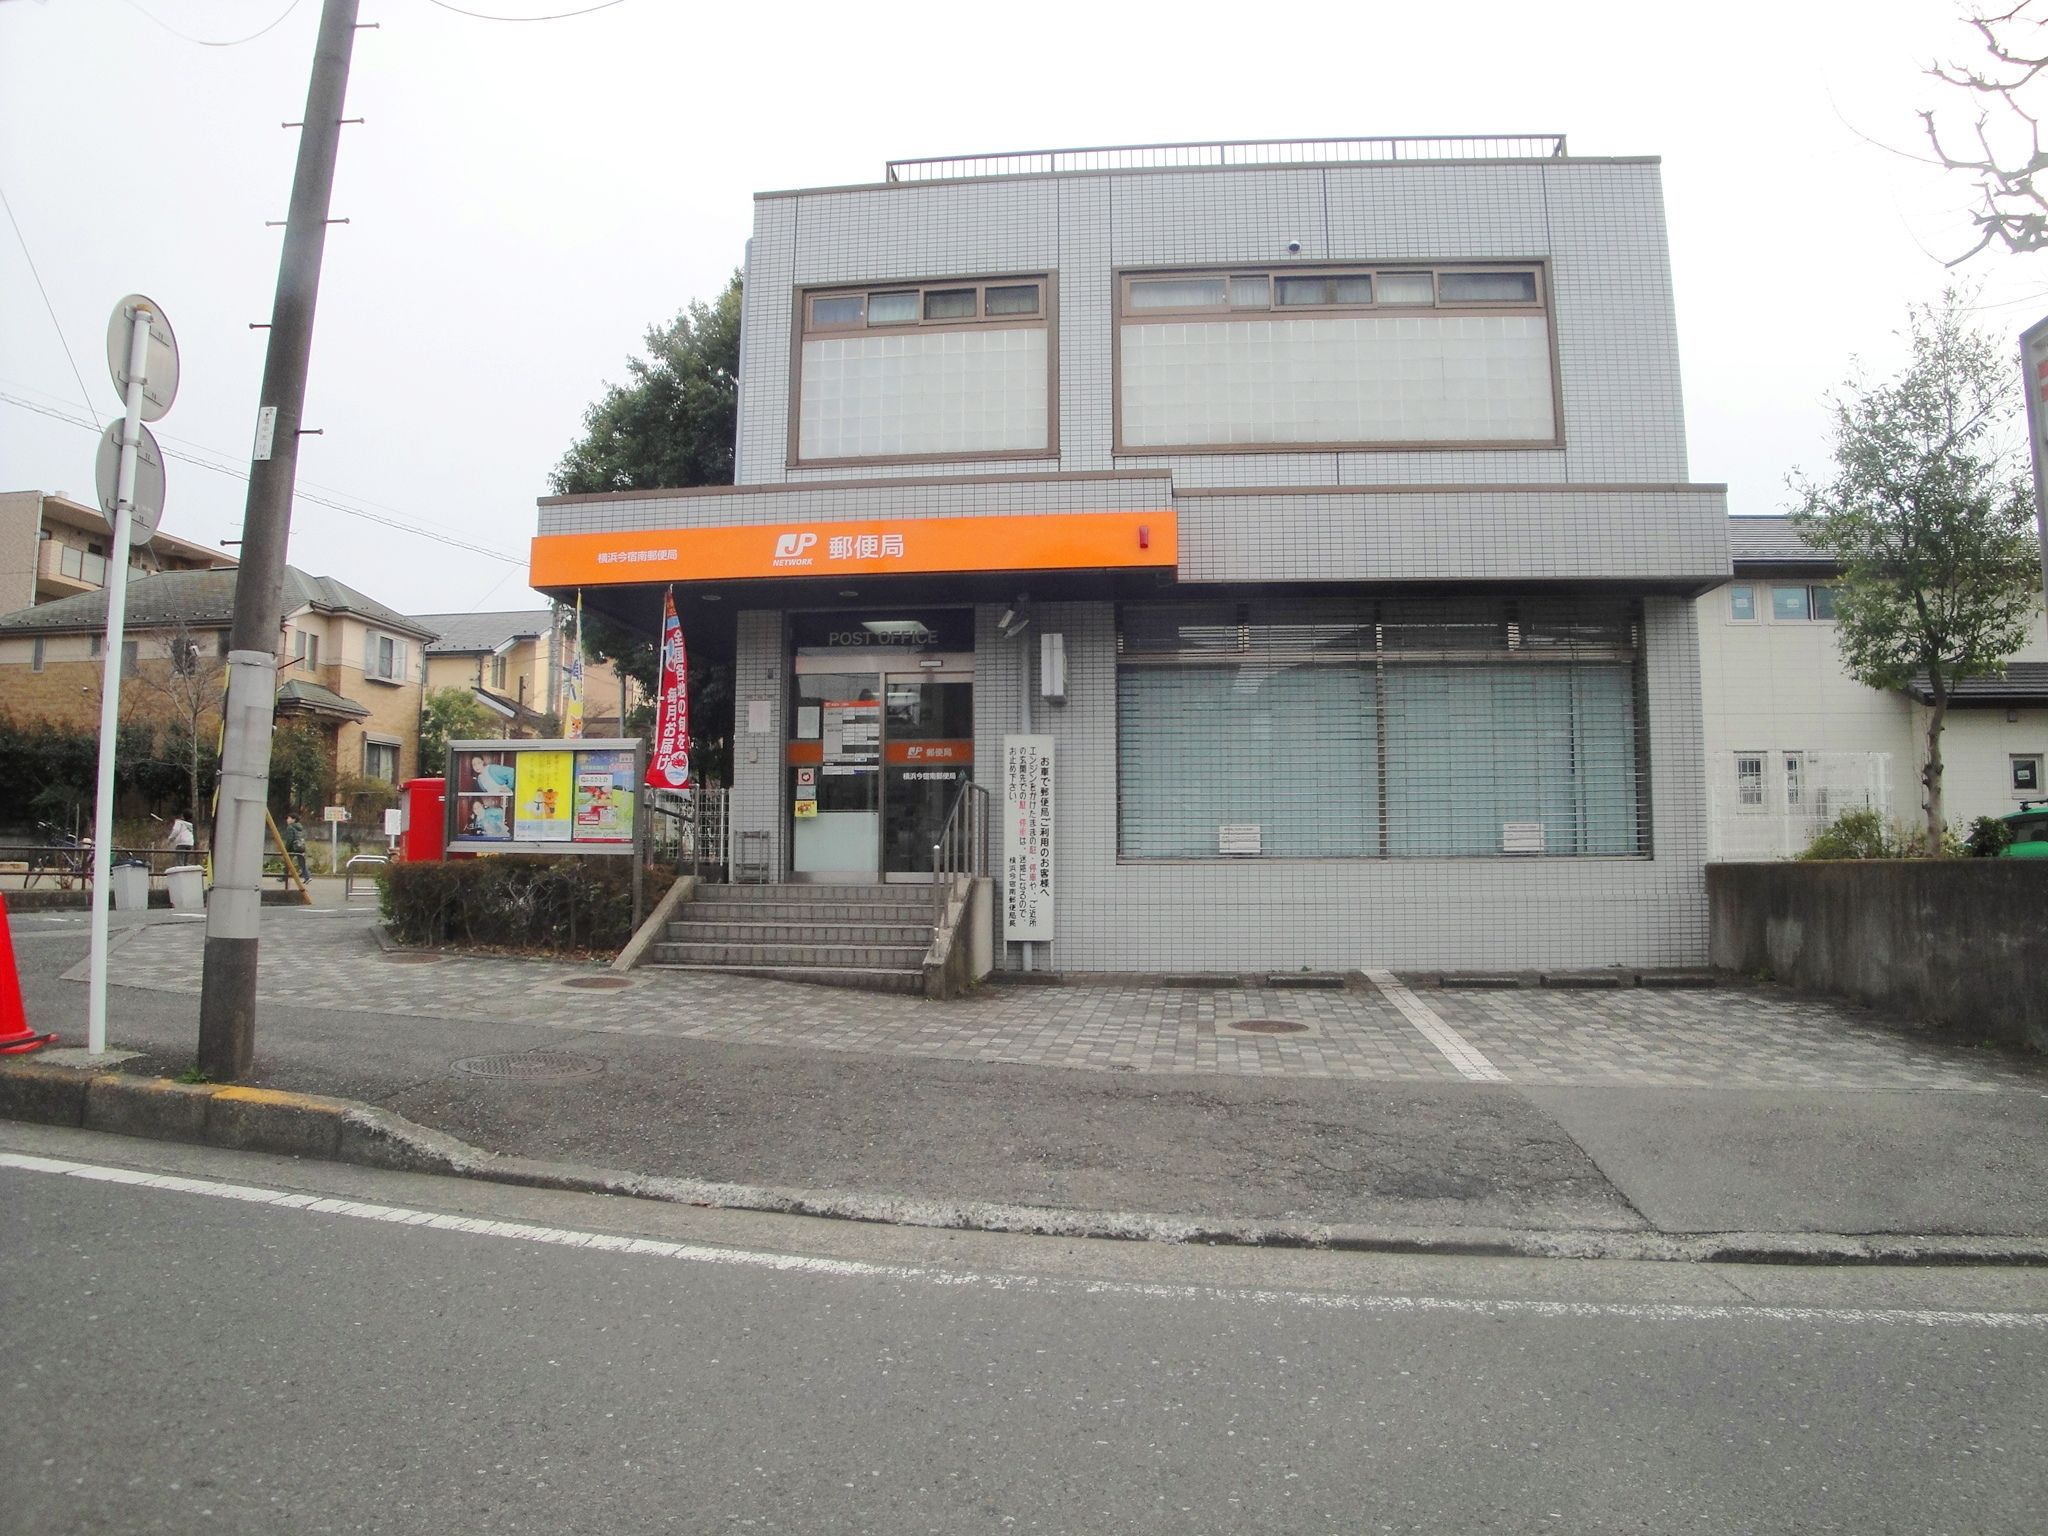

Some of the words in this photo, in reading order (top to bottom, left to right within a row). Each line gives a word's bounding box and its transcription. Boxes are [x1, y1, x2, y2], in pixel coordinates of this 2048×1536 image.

[597, 549, 678, 564] 横浜今宿南郵便局
[828, 534, 905, 560] 郵便局
[773, 558, 813, 567] NETWORK
[829, 631, 872, 646] POST
[878, 630, 938, 645] OFFICE
[656, 687, 677, 771] 毎月お届け
[1040, 757, 1051, 897] お車で郵便局ご利用のお客様へ
